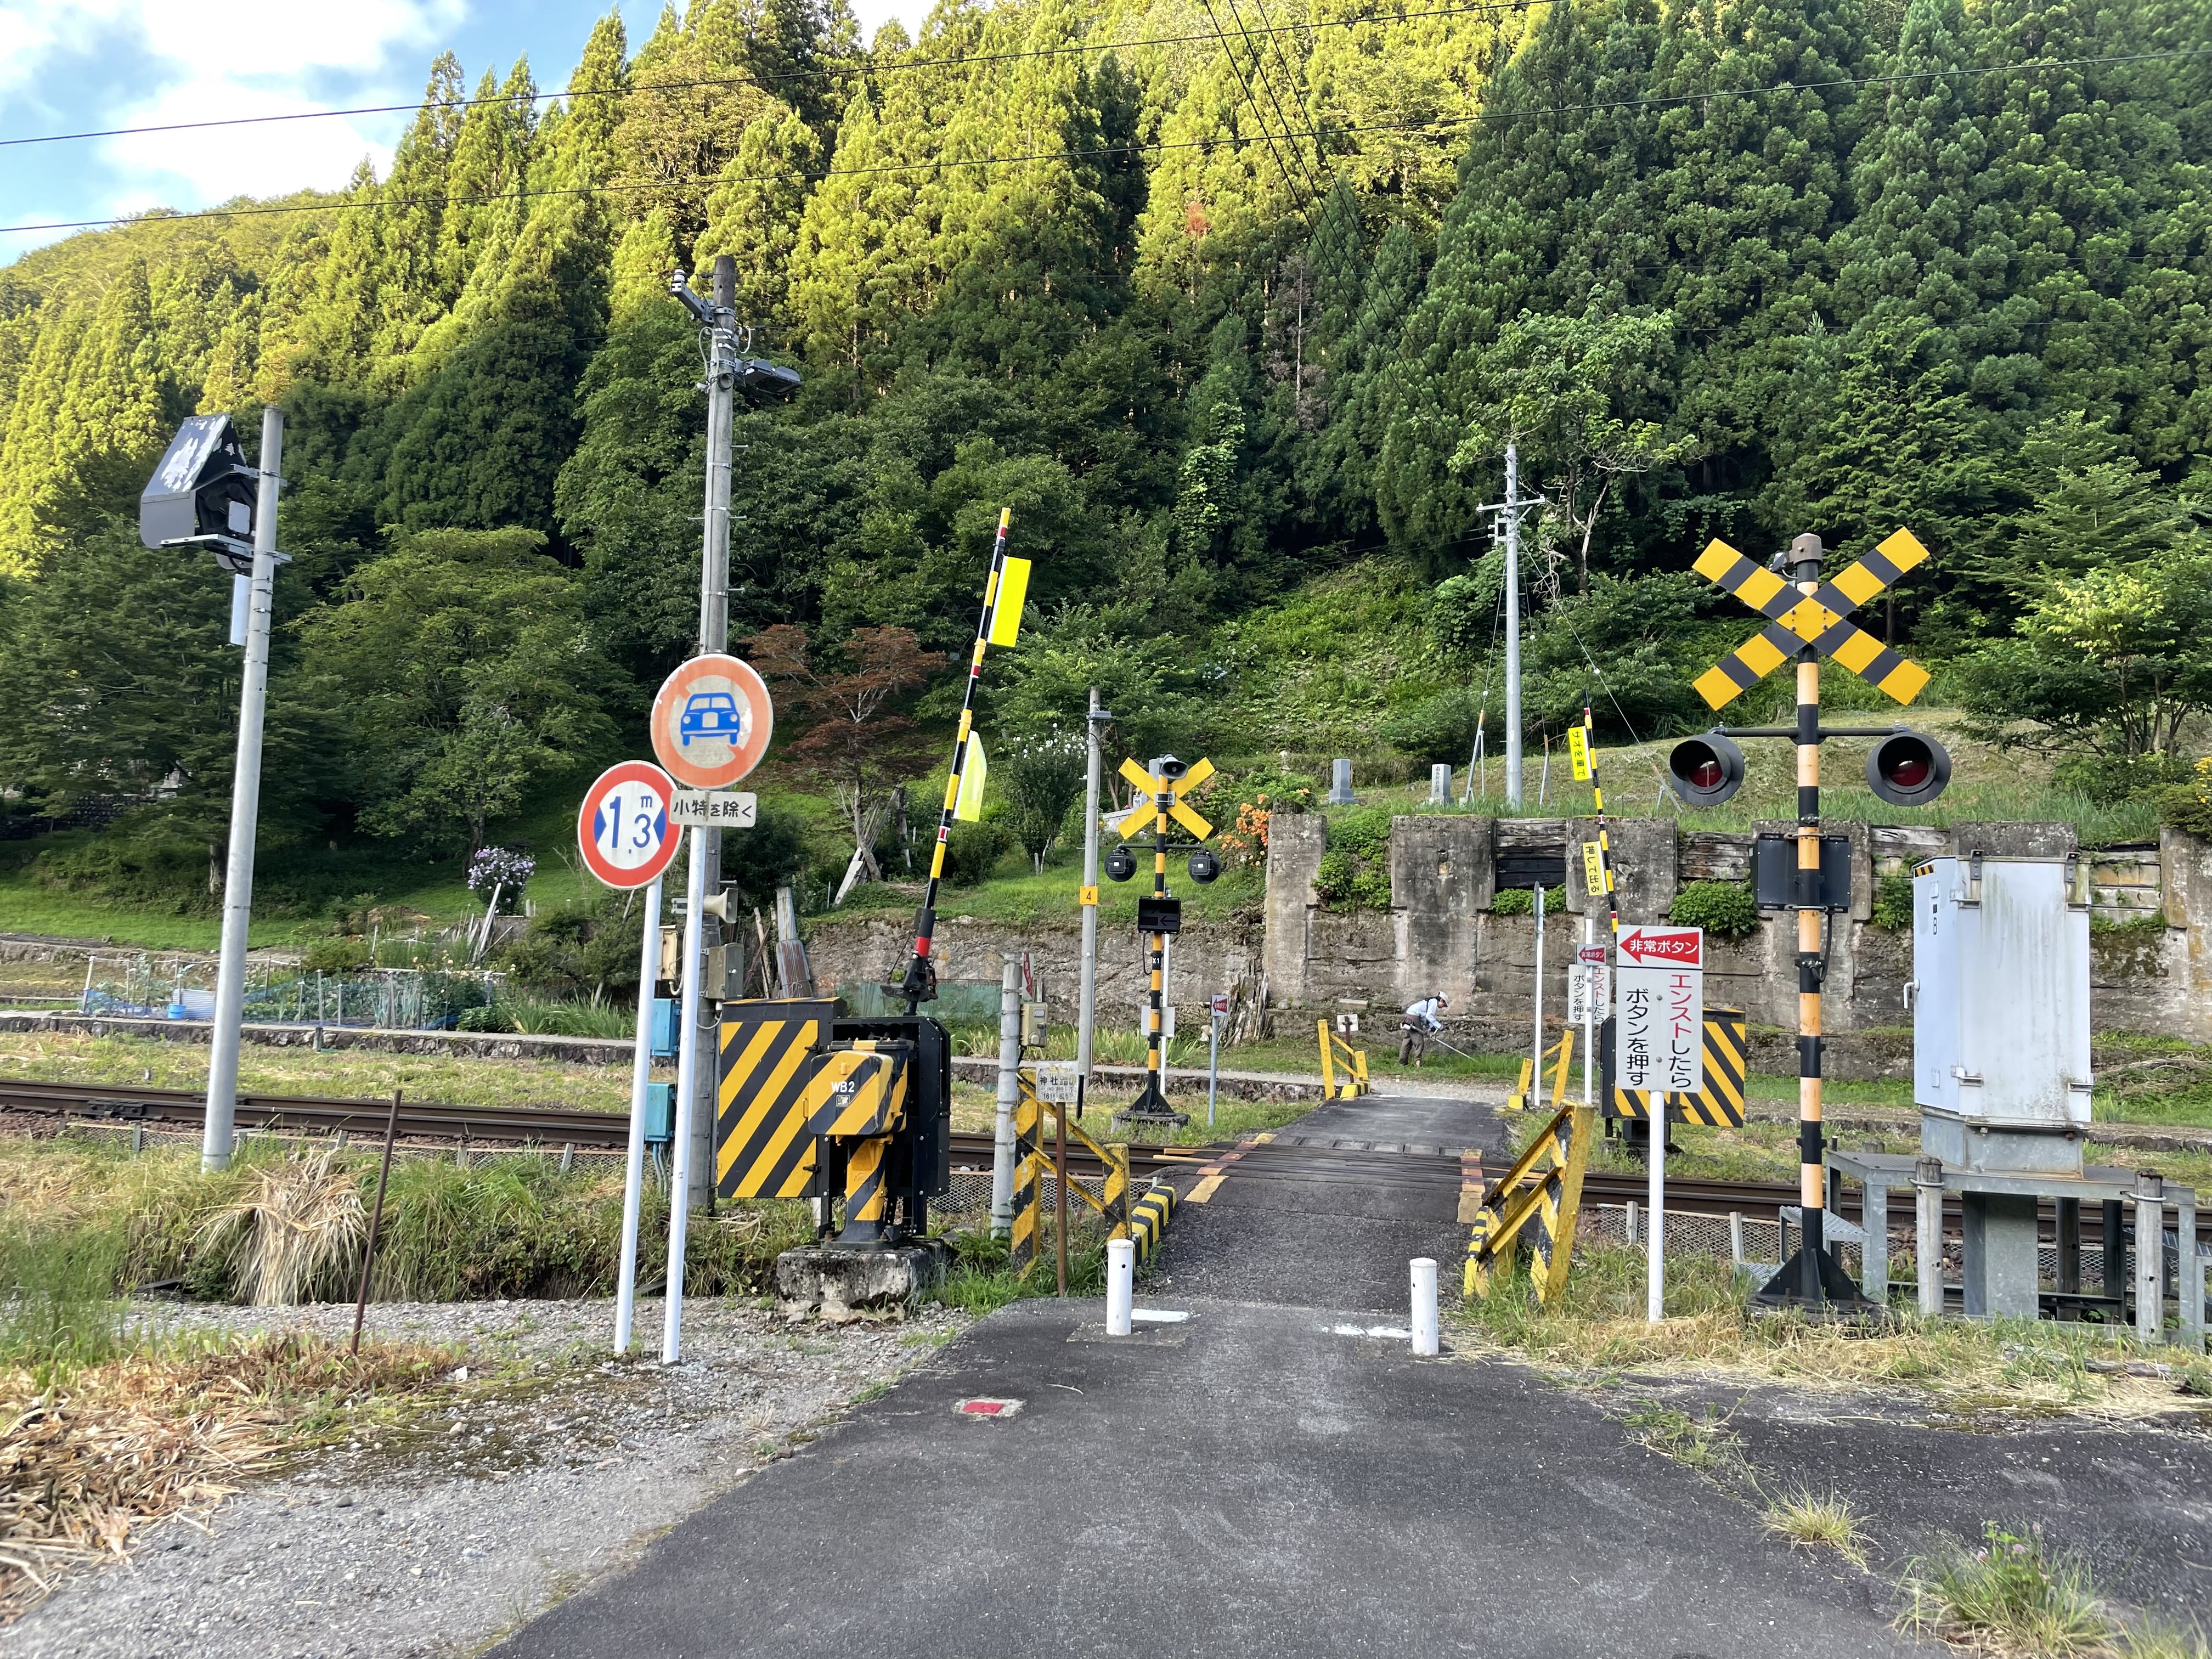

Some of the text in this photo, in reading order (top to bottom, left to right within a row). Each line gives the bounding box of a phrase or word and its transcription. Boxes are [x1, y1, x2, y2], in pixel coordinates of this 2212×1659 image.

[1572, 731, 1585, 776] サオを車で
[673, 799, 752, 818] 小特を除く
[1585, 845, 1600, 893] 押して出る
[1086, 891, 1091, 901] 4
[1630, 939, 1698, 955] 非常ボタン
[1573, 974, 1585, 1021] ボタンを押す
[1594, 968, 1605, 1022] エンストしたら
[1626, 988, 1650, 1086] ボタンを押す
[1668, 974, 1692, 1088] エンストしたら
[831, 1081, 855, 1092] WB2
